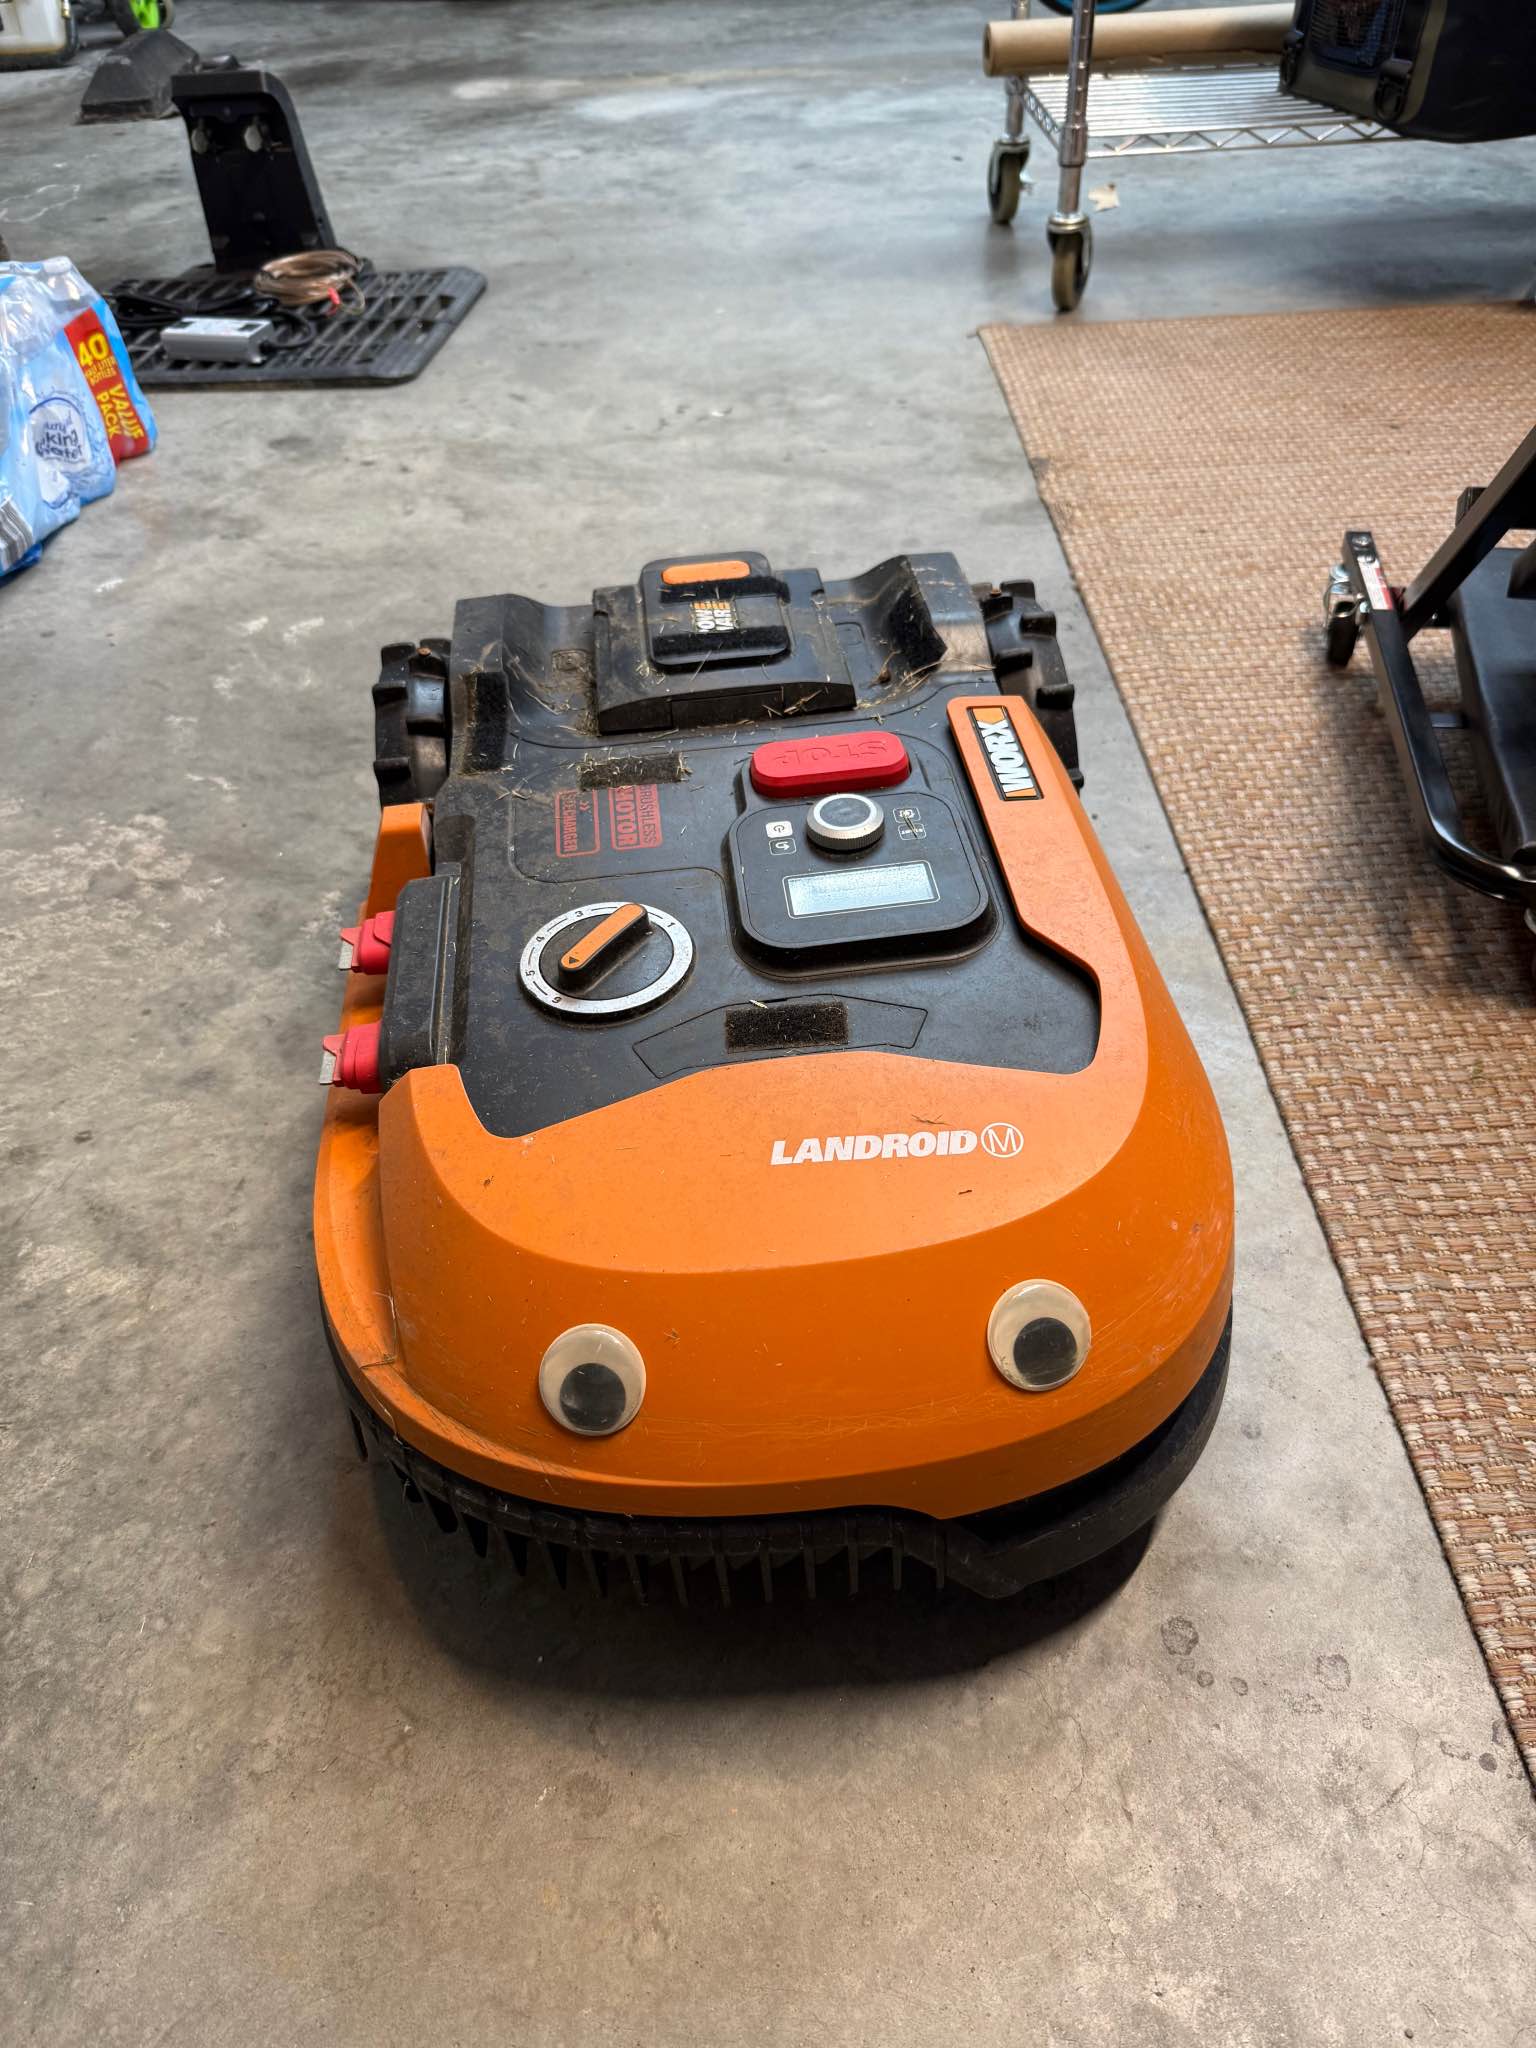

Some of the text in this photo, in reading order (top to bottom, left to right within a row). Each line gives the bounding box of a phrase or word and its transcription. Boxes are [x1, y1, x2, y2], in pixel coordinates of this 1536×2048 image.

[79, 332, 109, 367] 40
[96, 391, 122, 438] PACK
[109, 383, 145, 439] VALUE
[773, 740, 888, 764] STOP
[977, 719, 1034, 793] WORX
[615, 786, 638, 846] MOTOR
[575, 910, 584, 918] 3
[770, 1125, 1020, 1165] LANDROID M
